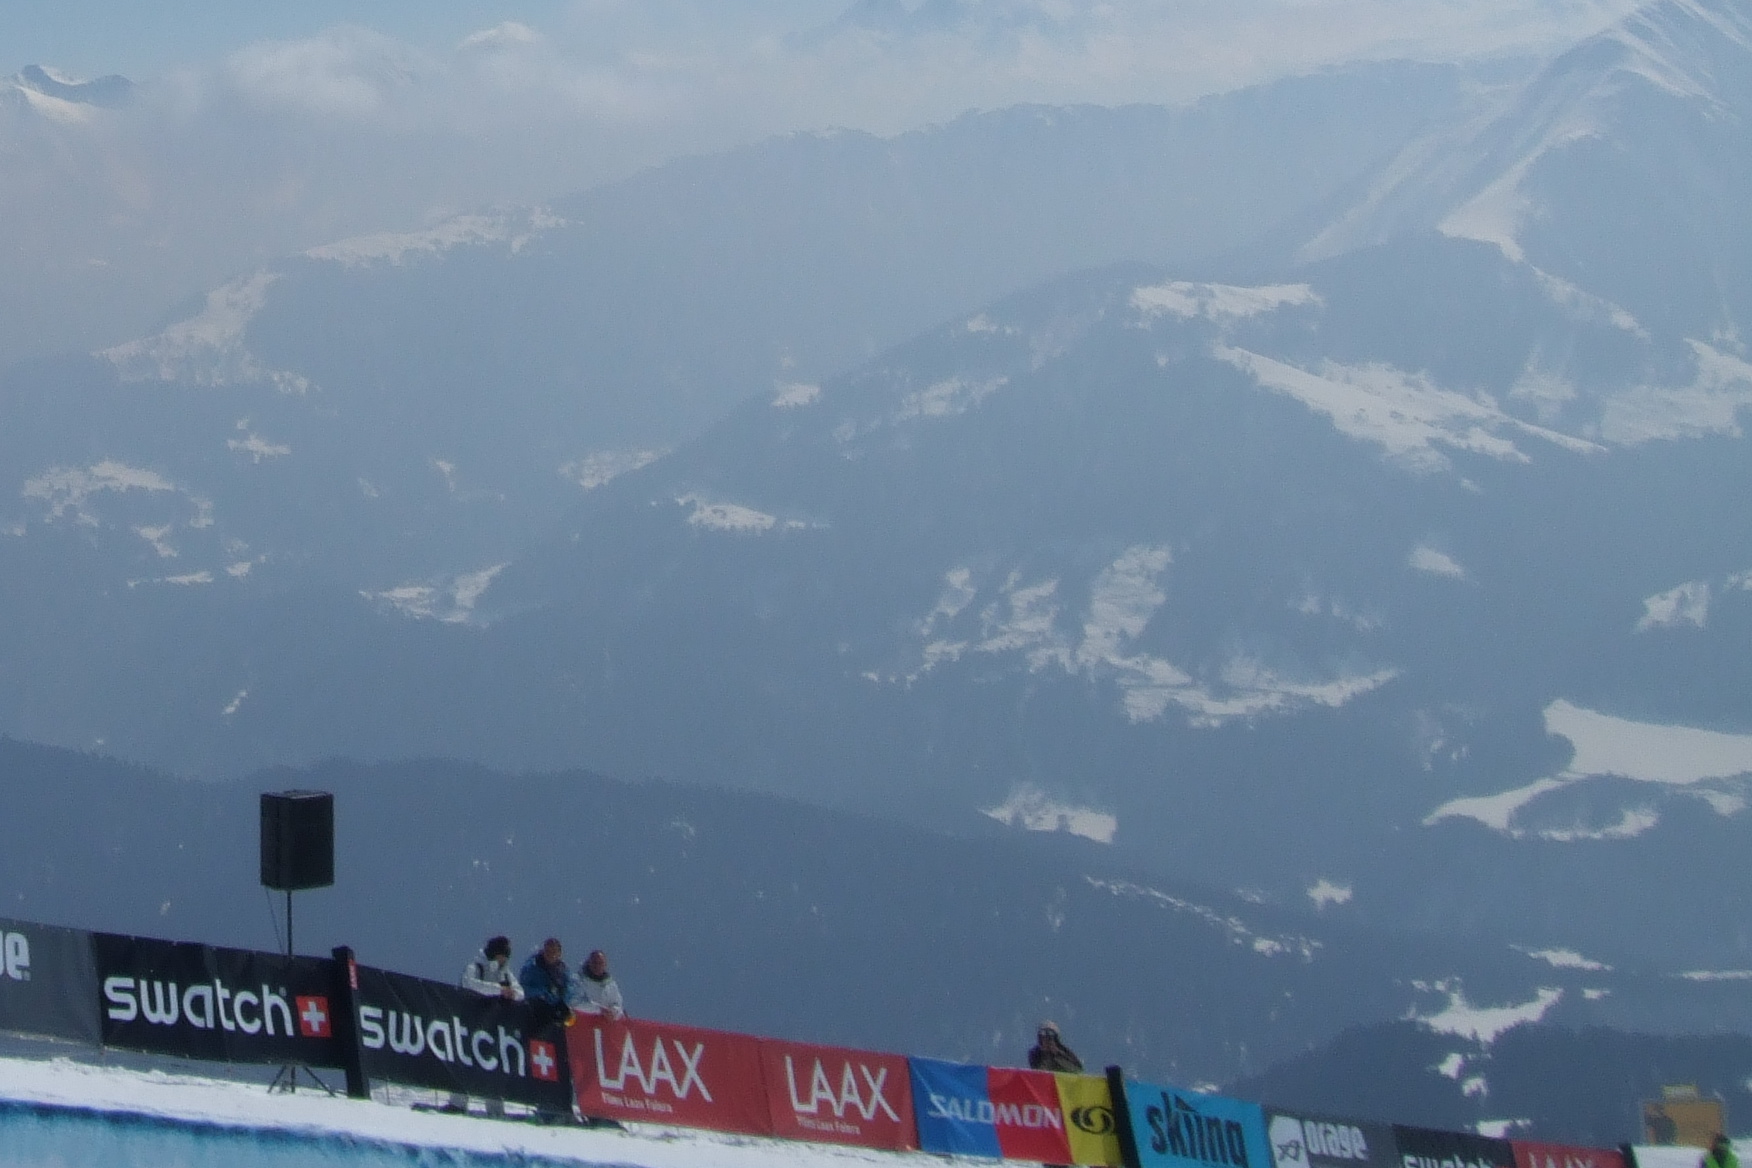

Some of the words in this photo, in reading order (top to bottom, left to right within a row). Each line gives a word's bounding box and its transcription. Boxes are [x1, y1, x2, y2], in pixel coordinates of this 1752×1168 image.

[103, 976, 294, 1037] swatch
[359, 1005, 526, 1077] swatch
[594, 1027, 713, 1103] LAAX
[784, 1055, 901, 1123] LAAX
[927, 1093, 1063, 1130] SALOMON
